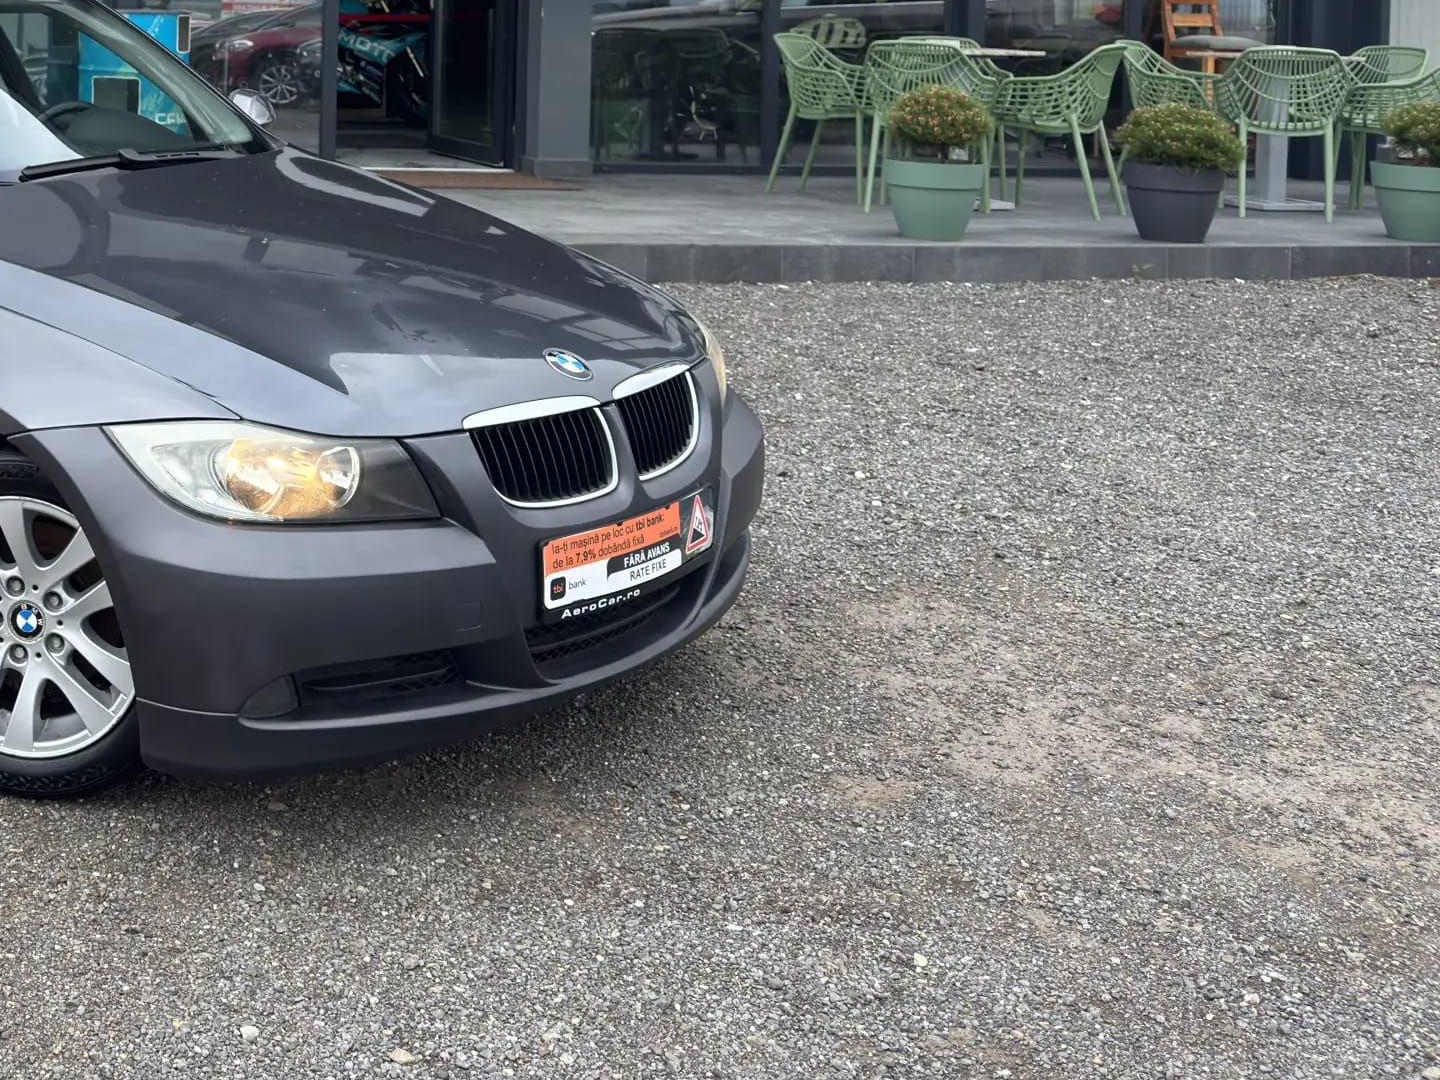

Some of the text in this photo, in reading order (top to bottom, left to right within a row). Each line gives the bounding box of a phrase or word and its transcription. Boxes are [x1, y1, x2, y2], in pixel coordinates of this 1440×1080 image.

[601, 532, 611, 544] pe
[613, 528, 623, 538] loc
[625, 524, 634, 534] cu
[635, 520, 645, 531] tbi
[552, 557, 564, 569] de
[565, 555, 574, 566] la
[576, 549, 597, 563] 7,9%
[632, 534, 645, 546] fixă
[623, 542, 670, 568] FĂRĂ AVANS
[629, 558, 667, 581] RATE FIXE
[552, 583, 564, 594] tbi
[568, 578, 587, 590] bank
[561, 588, 641, 619] AeroCar.ro
